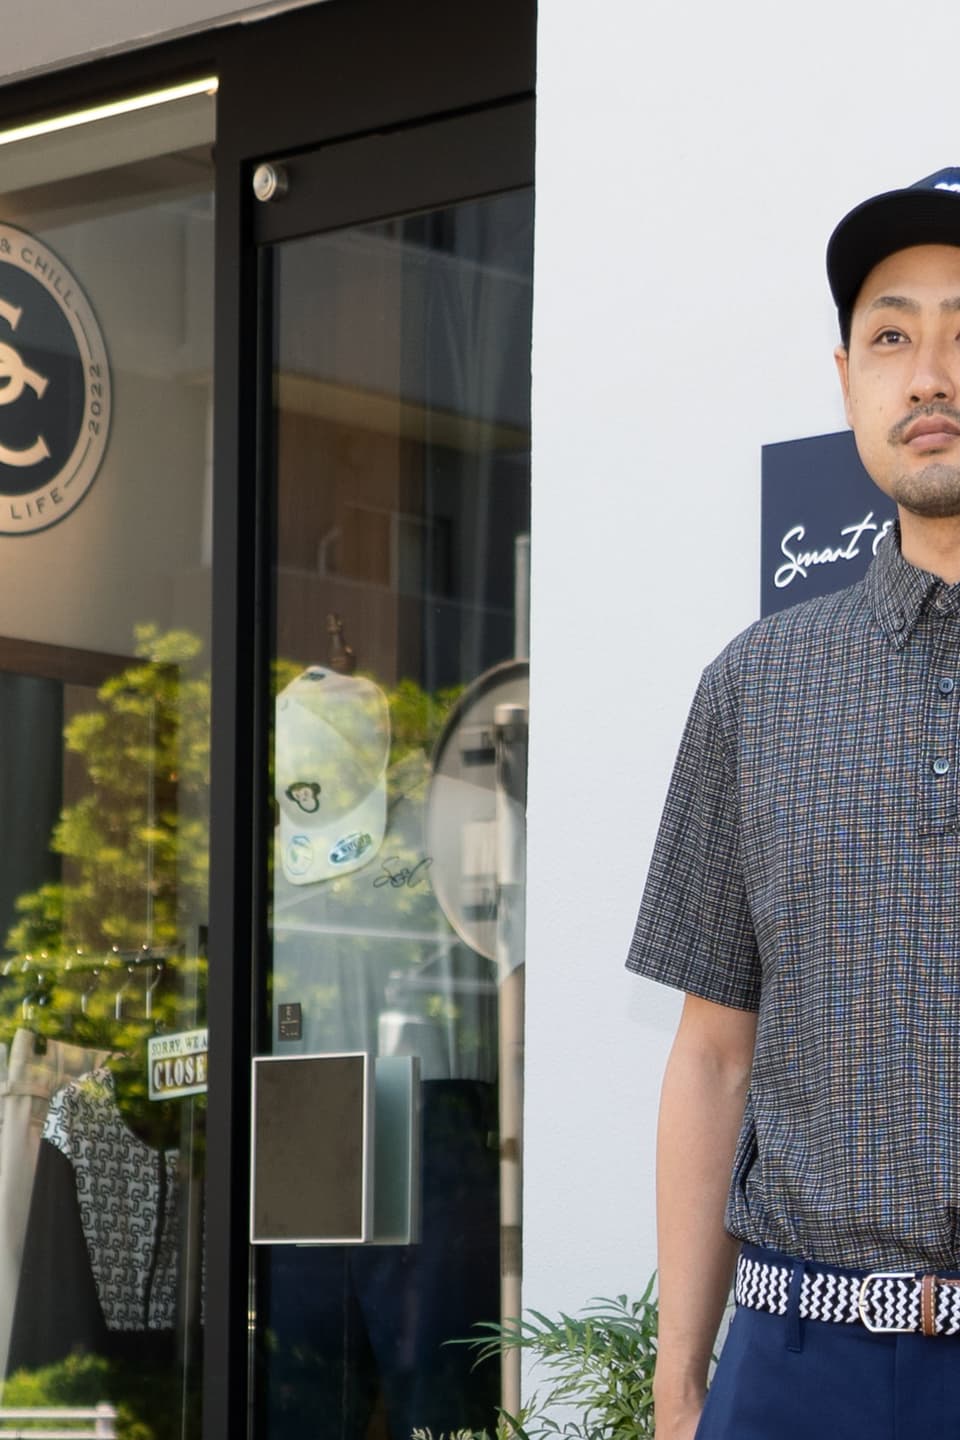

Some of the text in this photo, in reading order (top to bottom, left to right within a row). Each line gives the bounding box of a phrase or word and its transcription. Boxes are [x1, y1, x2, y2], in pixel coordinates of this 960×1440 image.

[20, 247, 72, 309] CHILL
[88, 364, 101, 436] 2022
[10, 488, 63, 520] LIFE
[774, 511, 878, 588] Smart
